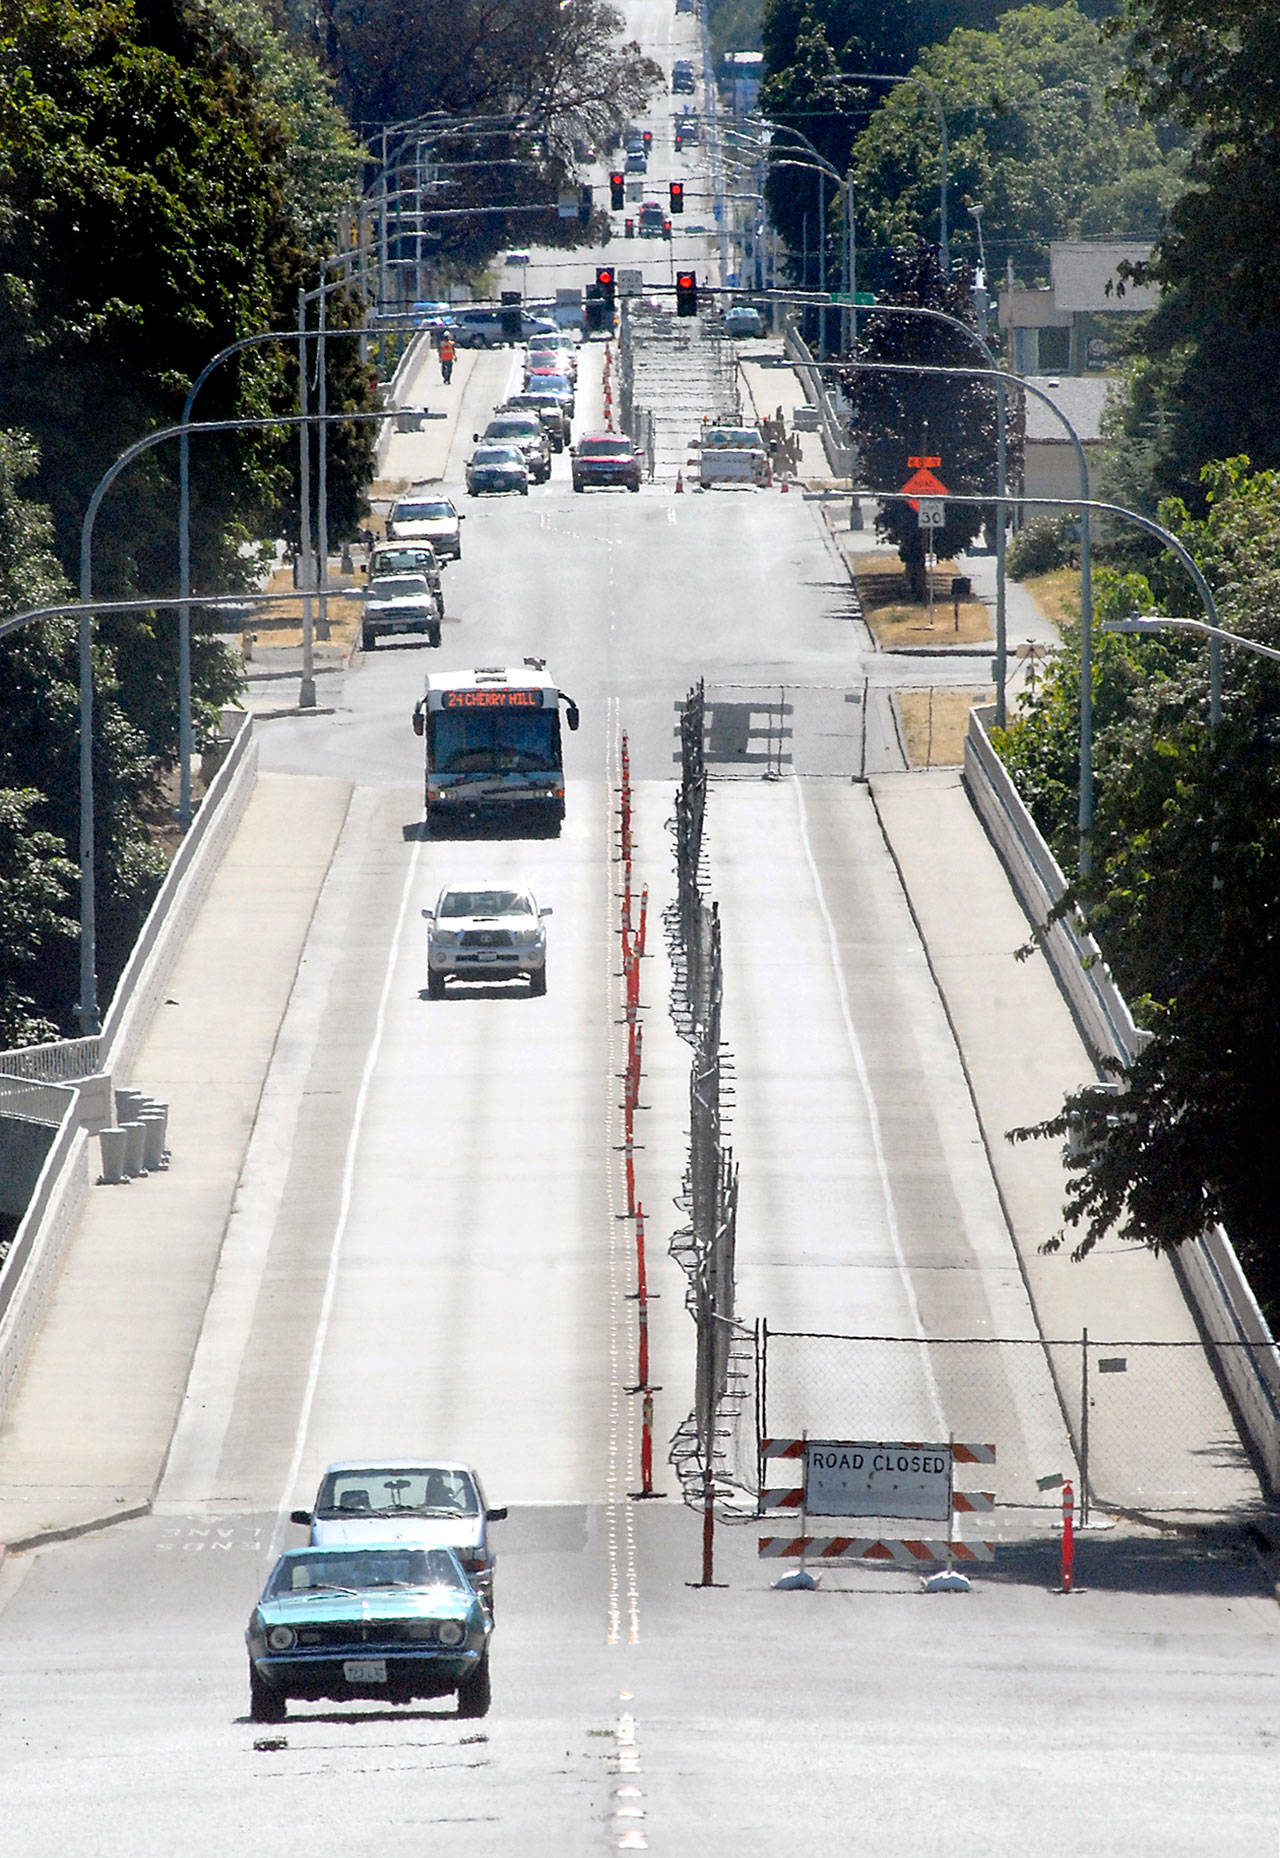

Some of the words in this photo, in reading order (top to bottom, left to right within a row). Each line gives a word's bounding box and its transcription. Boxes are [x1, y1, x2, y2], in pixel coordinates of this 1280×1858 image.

[922, 511, 941, 524] 30
[448, 692, 464, 706] 24
[465, 692, 506, 706] CHERRY
[508, 691, 536, 706] HILL
[812, 1452, 865, 1470] ROAD
[872, 1454, 946, 1474] CLOSED
